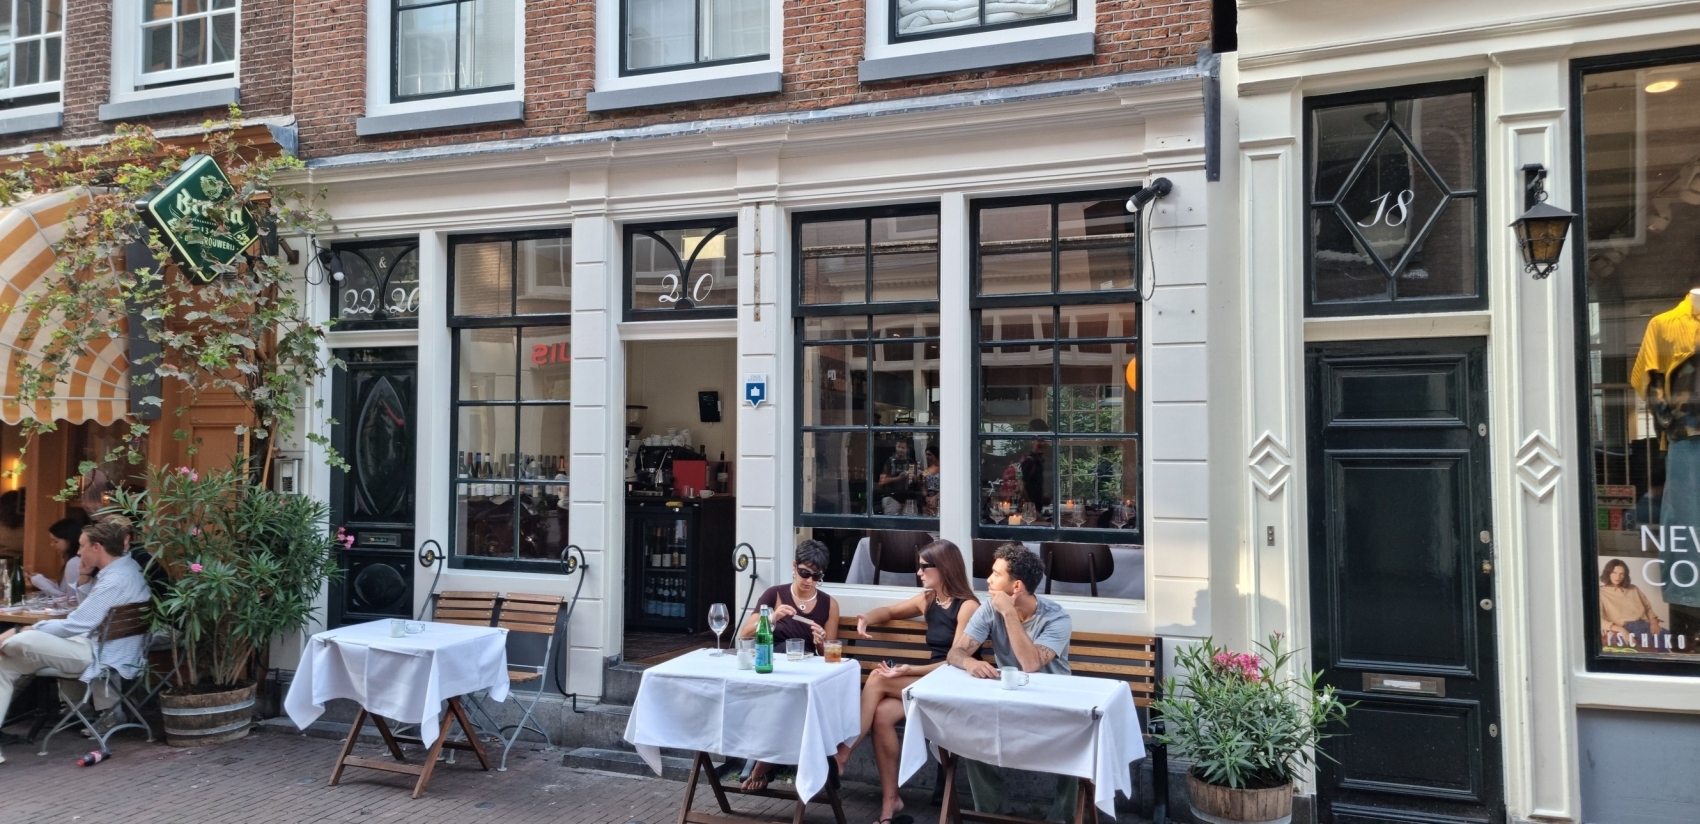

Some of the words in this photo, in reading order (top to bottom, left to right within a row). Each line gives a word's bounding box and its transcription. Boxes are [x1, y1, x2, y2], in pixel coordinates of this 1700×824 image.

[1357, 189, 1414, 228] 18
[378, 256, 387, 269] &
[342, 288, 376, 315] 22
[389, 287, 419, 314] 20
[658, 273, 714, 303] 20
